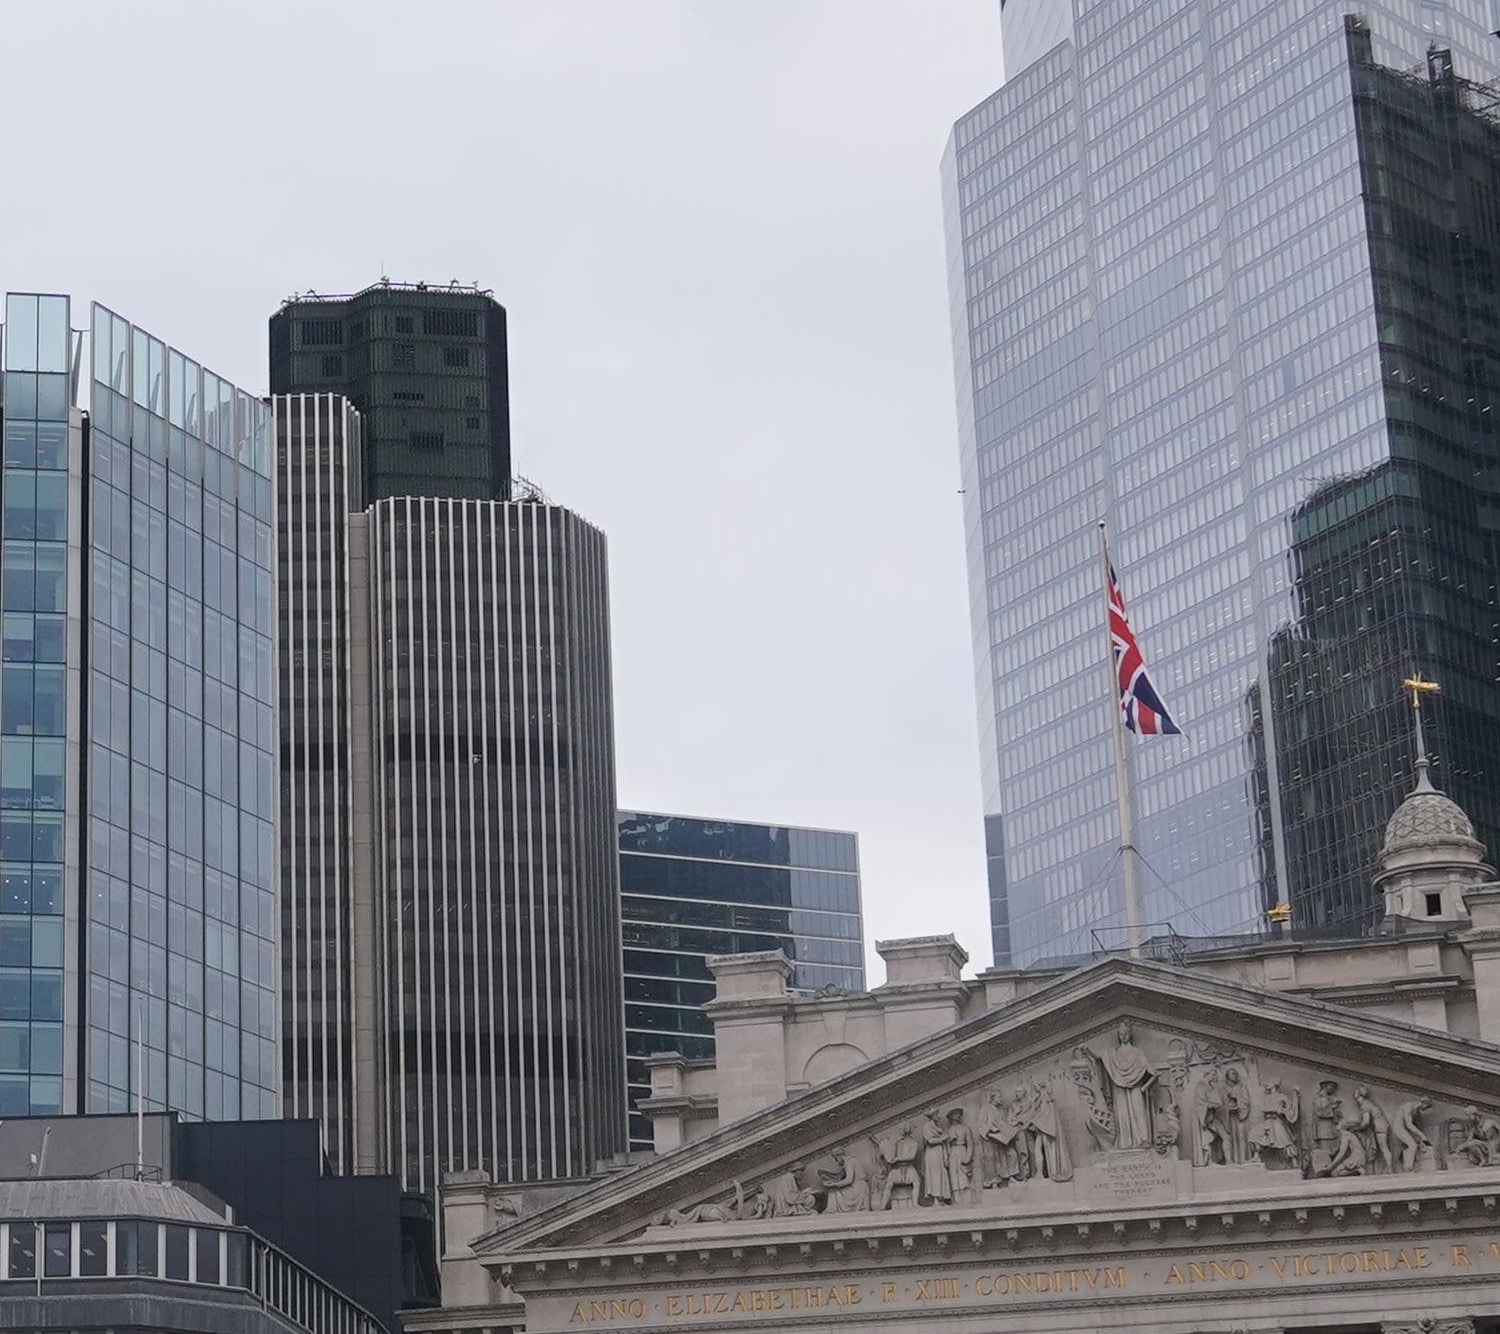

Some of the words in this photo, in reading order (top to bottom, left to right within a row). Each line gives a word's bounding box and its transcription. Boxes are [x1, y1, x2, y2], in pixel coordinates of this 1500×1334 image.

[569, 1298, 647, 1323] ANNO
[666, 1284, 863, 1317] ELIZABETHAE
[881, 1281, 898, 1303] R
[915, 1277, 960, 1300] XIII
[976, 1267, 1126, 1296] CONDITVM
[1164, 1258, 1250, 1284] ANNO
[1270, 1246, 1433, 1277] VICTORIAE
[1451, 1244, 1472, 1266] R
